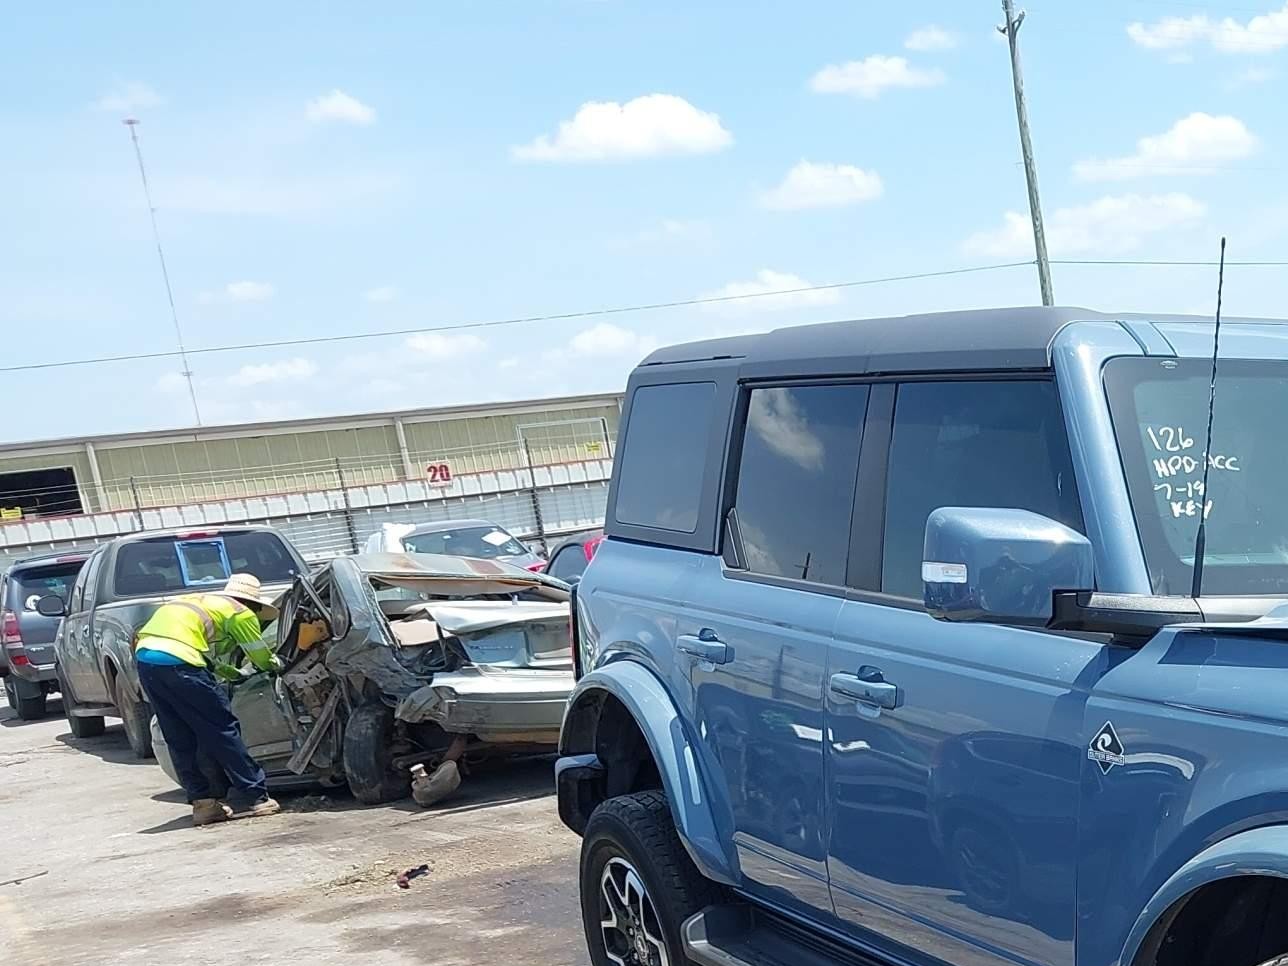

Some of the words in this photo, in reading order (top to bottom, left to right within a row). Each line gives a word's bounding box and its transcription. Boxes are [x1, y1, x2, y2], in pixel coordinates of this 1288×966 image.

[1147, 427, 1193, 451] 126
[427, 464, 450, 482] 20
[1170, 500, 1213, 519] KEY
